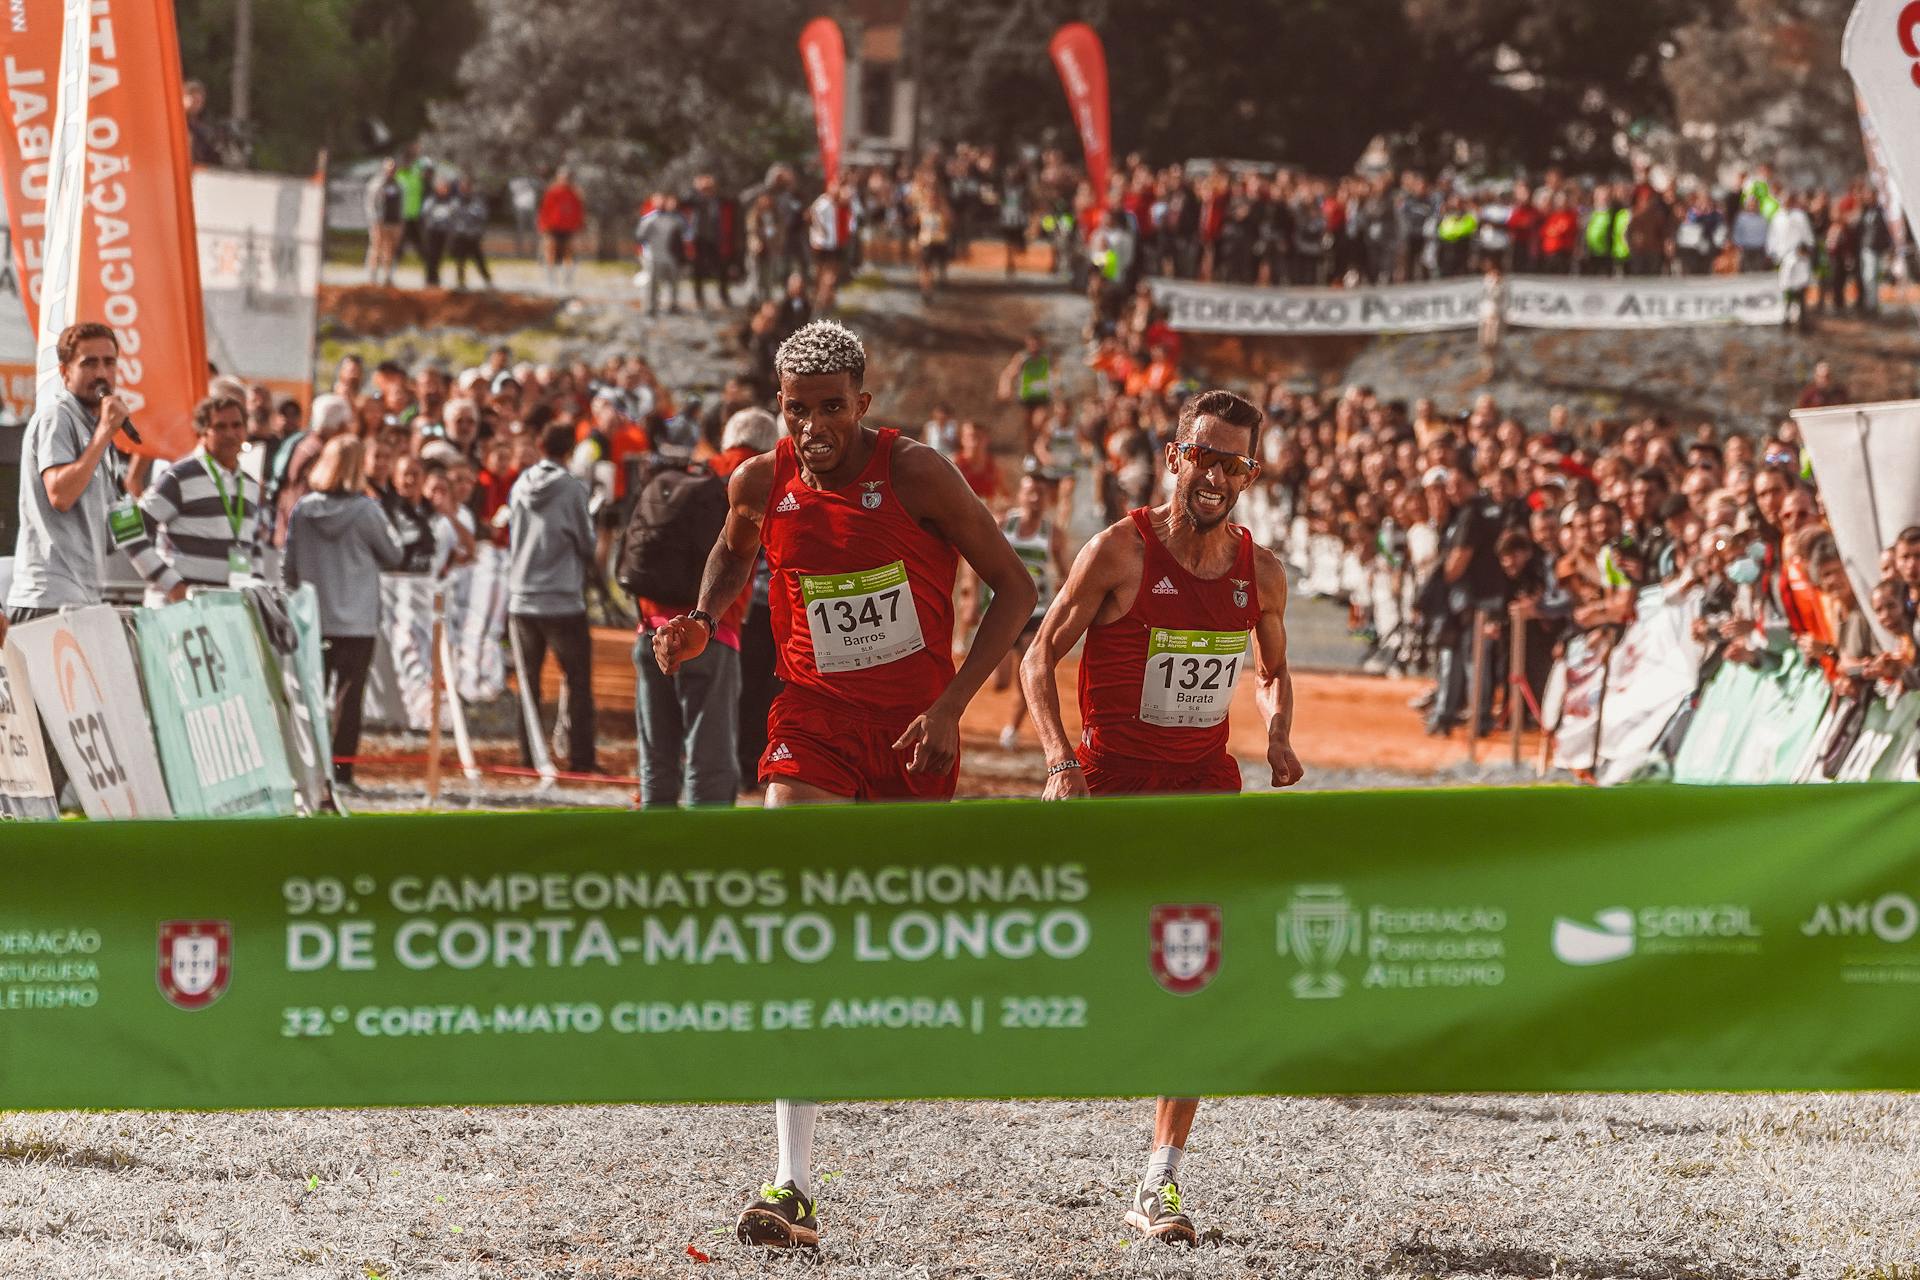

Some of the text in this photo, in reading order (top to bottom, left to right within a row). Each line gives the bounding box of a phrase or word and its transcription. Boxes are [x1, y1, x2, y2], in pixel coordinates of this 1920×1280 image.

[776, 503, 800, 513] adidas
[1151, 587, 1179, 596] adidas
[814, 589, 900, 634] 1347
[843, 631, 886, 646] Barros
[1158, 656, 1238, 690] 1321
[1176, 692, 1214, 704] Barata
[389, 868, 788, 913] CAMPEONATOS
[801, 863, 1089, 906] NACIONAIS
[1369, 905, 1507, 933] FEDERAÇÃO
[286, 908, 1091, 971] DE CORTA-MATO LONGO
[1361, 962, 1505, 989] ATLETISMO
[355, 1003, 603, 1036] CORTA-MATO
[610, 1000, 754, 1034] CIDADE
[762, 999, 813, 1031] DE
[821, 997, 966, 1030] AMORA
[1000, 995, 1088, 1029] 2022
